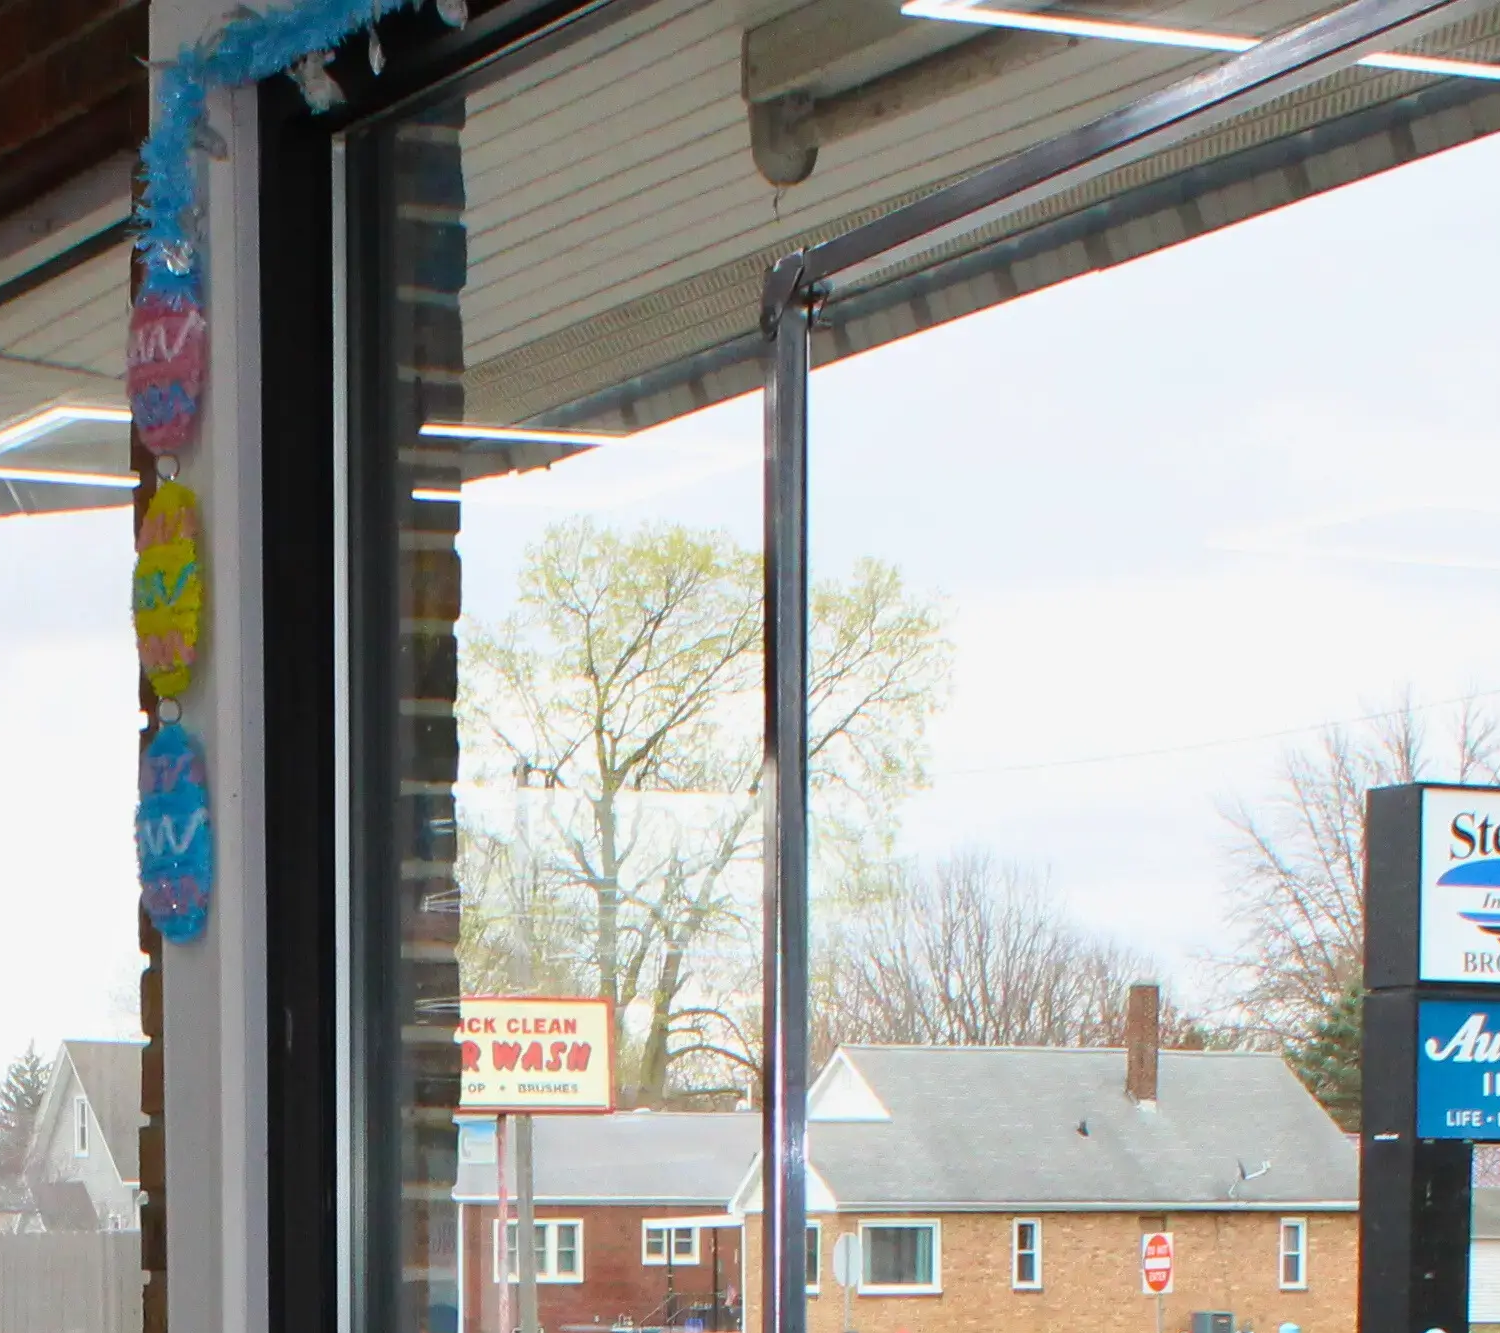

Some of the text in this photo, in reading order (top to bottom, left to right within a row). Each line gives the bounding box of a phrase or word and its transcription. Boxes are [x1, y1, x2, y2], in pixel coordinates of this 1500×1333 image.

[506, 1016, 577, 1035] CLEAN
[491, 1039, 592, 1074] WASH
[517, 1083, 579, 1095] BRUSHES
[1446, 1109, 1482, 1127] LIFE
